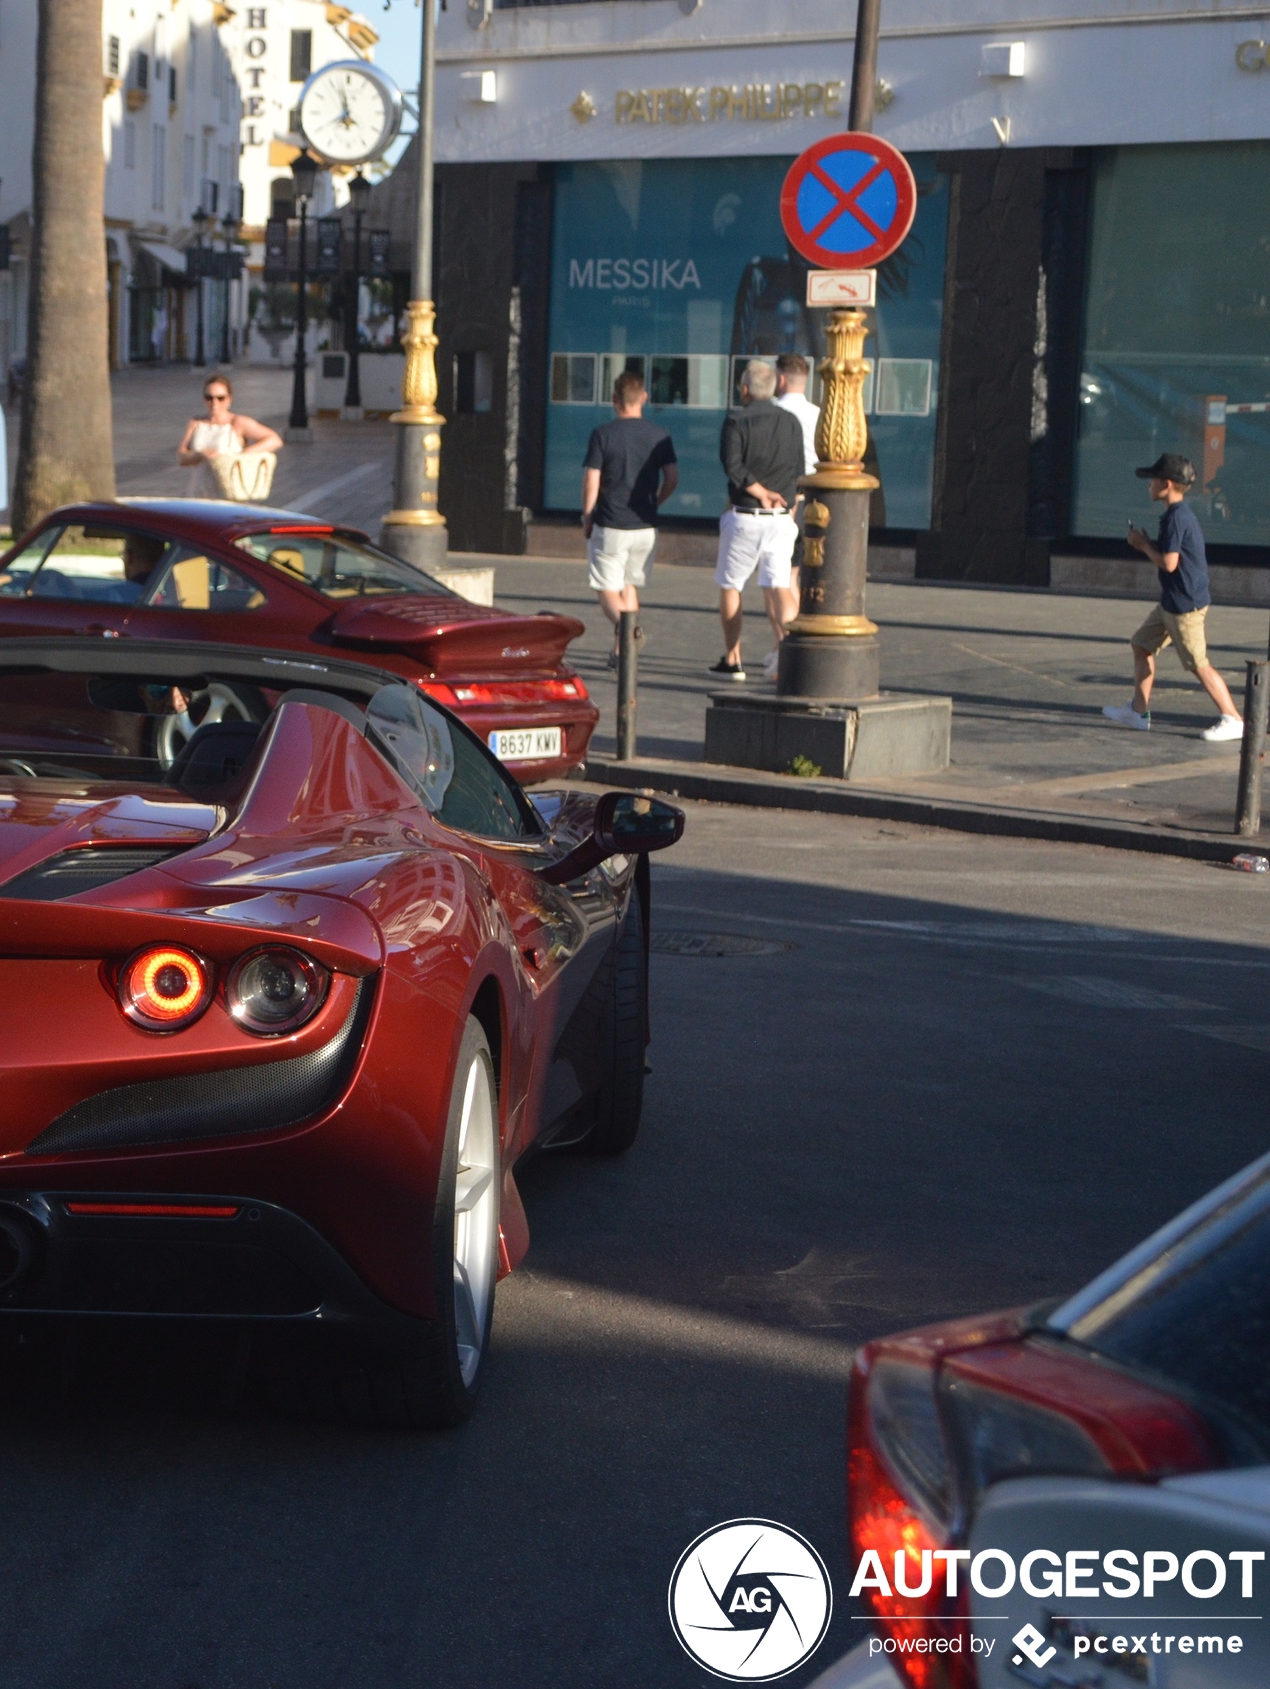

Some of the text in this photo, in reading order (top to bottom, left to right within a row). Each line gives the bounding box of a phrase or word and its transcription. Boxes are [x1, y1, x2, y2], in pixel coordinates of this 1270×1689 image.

[1235, 39, 1270, 75] G
[246, 7, 267, 146] HOTEL
[615, 80, 844, 124] PATEK PHILIPPE
[569, 258, 701, 289] MESSIKA
[500, 734, 532, 754] 8637
